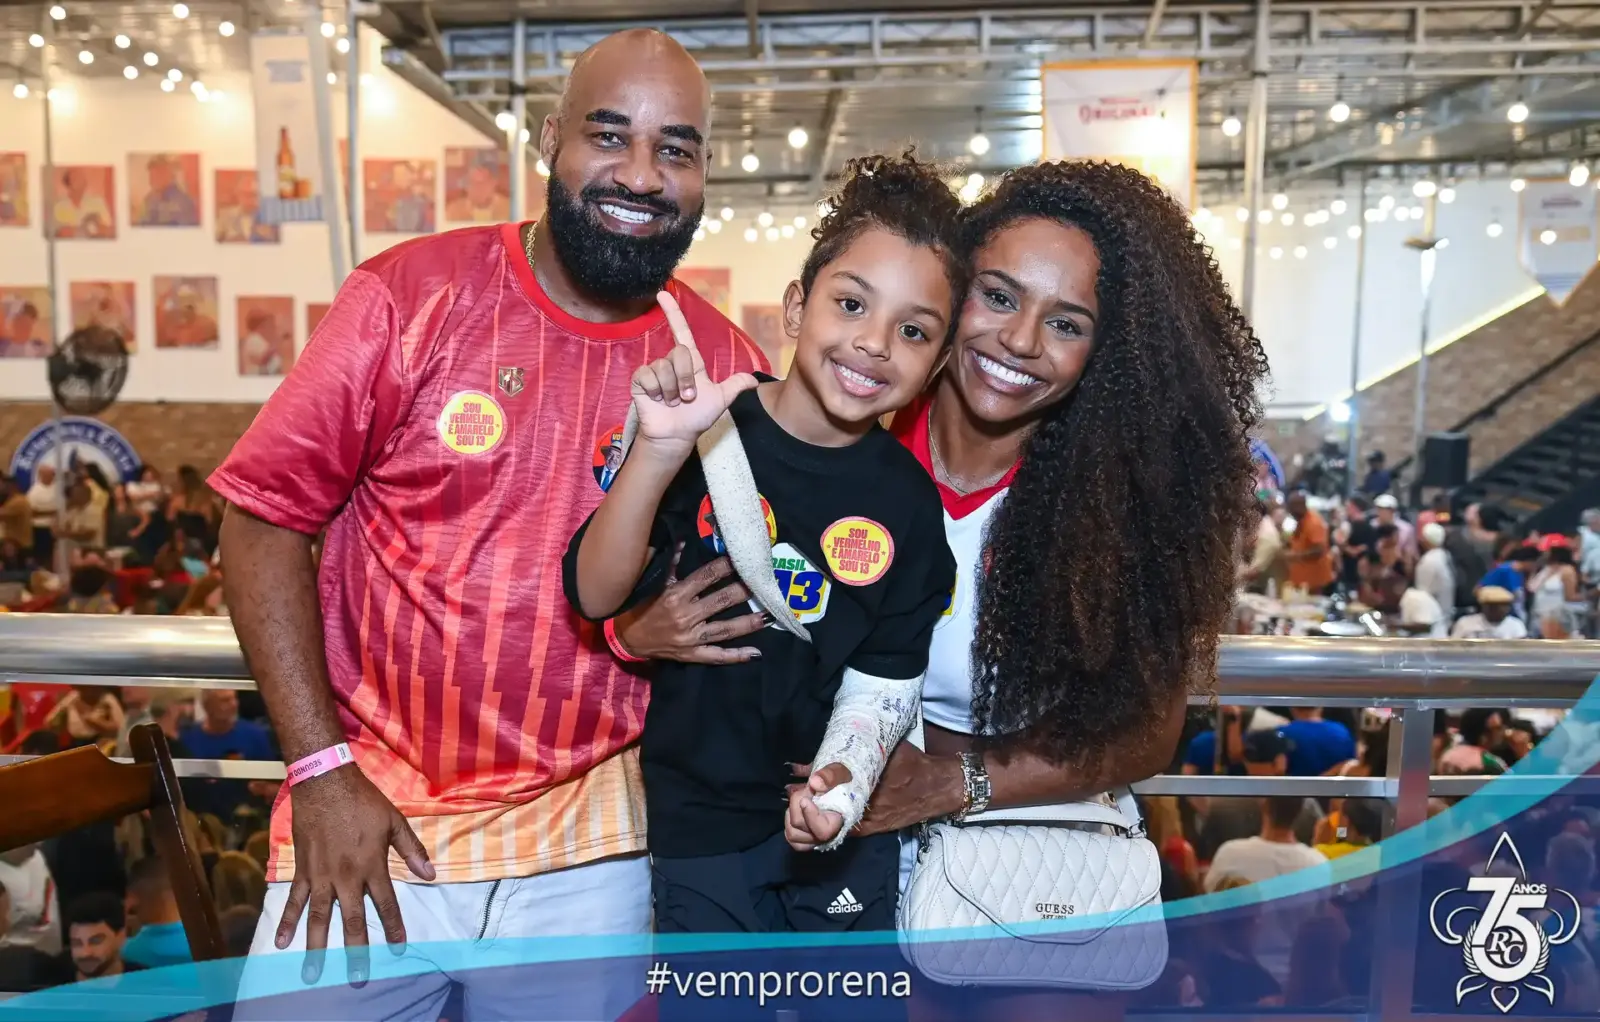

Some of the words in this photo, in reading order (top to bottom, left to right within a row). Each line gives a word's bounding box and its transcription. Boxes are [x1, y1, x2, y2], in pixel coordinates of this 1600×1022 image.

[463, 402, 481, 413] SOU
[450, 413, 495, 425] VERMELHO
[448, 424, 454, 434] E
[454, 424, 495, 436] AMARELO
[456, 435, 475, 446] SOU
[476, 435, 486, 446] 13
[848, 528, 868, 539] SOU
[833, 537, 881, 552] VERMELHO
[831, 548, 837, 559] E
[838, 548, 880, 564] AMARELO
[772, 557, 807, 571] RASIL
[839, 560, 858, 573] SOU
[859, 562, 870, 574] 13
[774, 569, 824, 611] 13
[294, 759, 322, 777] SEGUNDO
[827, 903, 863, 914] adidas
[1036, 903, 1074, 914] GUESS
